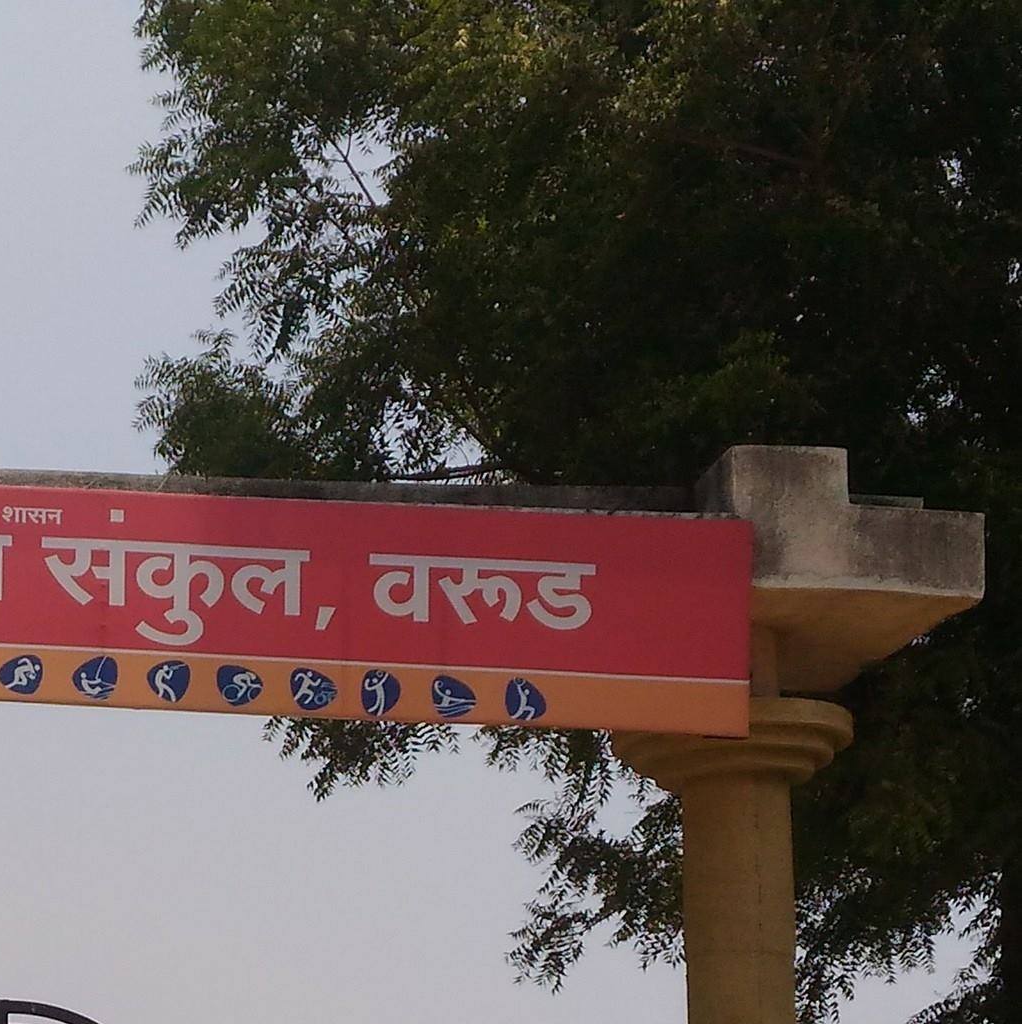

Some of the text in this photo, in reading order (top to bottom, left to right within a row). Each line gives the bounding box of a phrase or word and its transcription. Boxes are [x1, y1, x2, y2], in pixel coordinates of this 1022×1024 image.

[2, 505, 64, 526] शासन
[41, 508, 337, 648] संकुल,
[368, 552, 598, 632] वरूड
